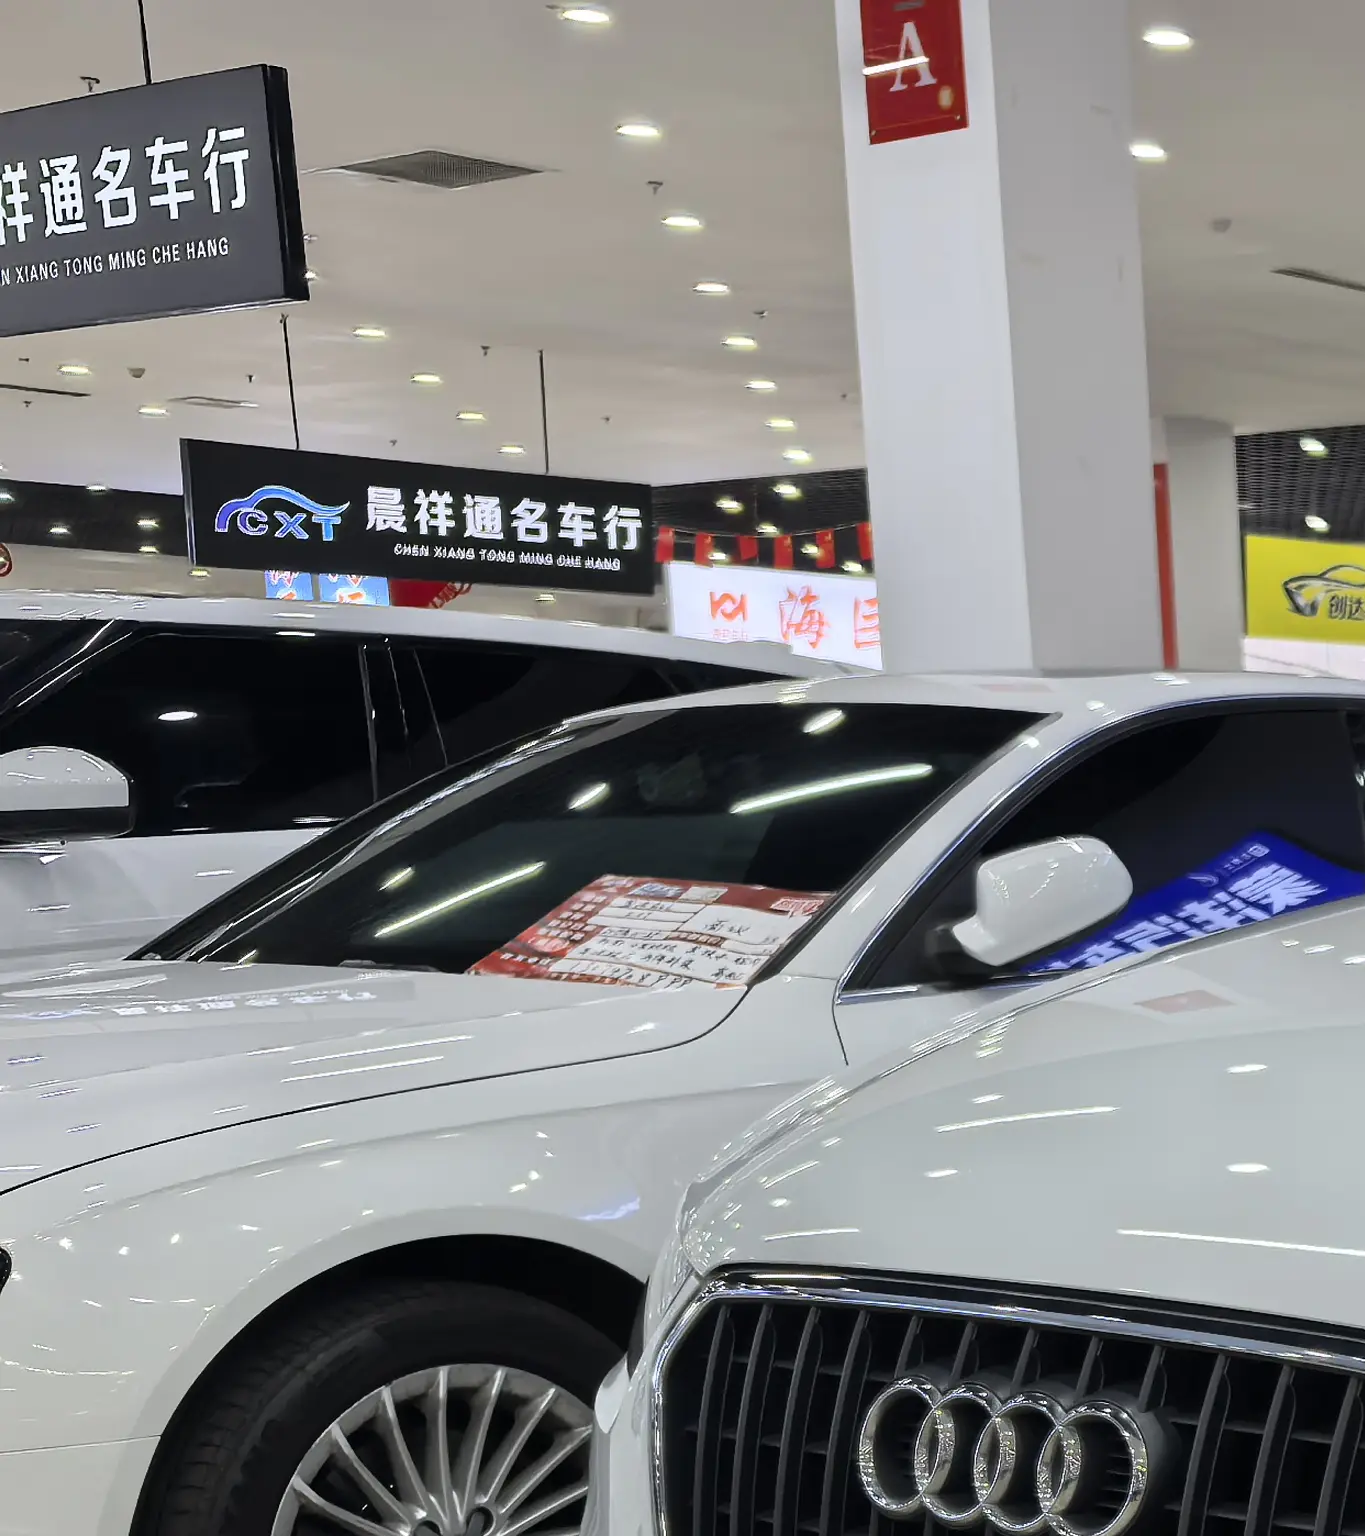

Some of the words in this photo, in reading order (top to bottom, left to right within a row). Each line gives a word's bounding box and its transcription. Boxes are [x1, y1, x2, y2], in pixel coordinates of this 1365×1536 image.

[889, 21, 938, 92] A
[0, 127, 249, 246] 祥通名车行
[15, 262, 59, 284] XIANG
[64, 255, 103, 277] TONG
[108, 249, 147, 271] MING
[152, 243, 181, 264] CHE
[186, 236, 229, 259] HANG
[238, 507, 343, 542] CXT
[366, 485, 642, 551] 晨祥通名车行
